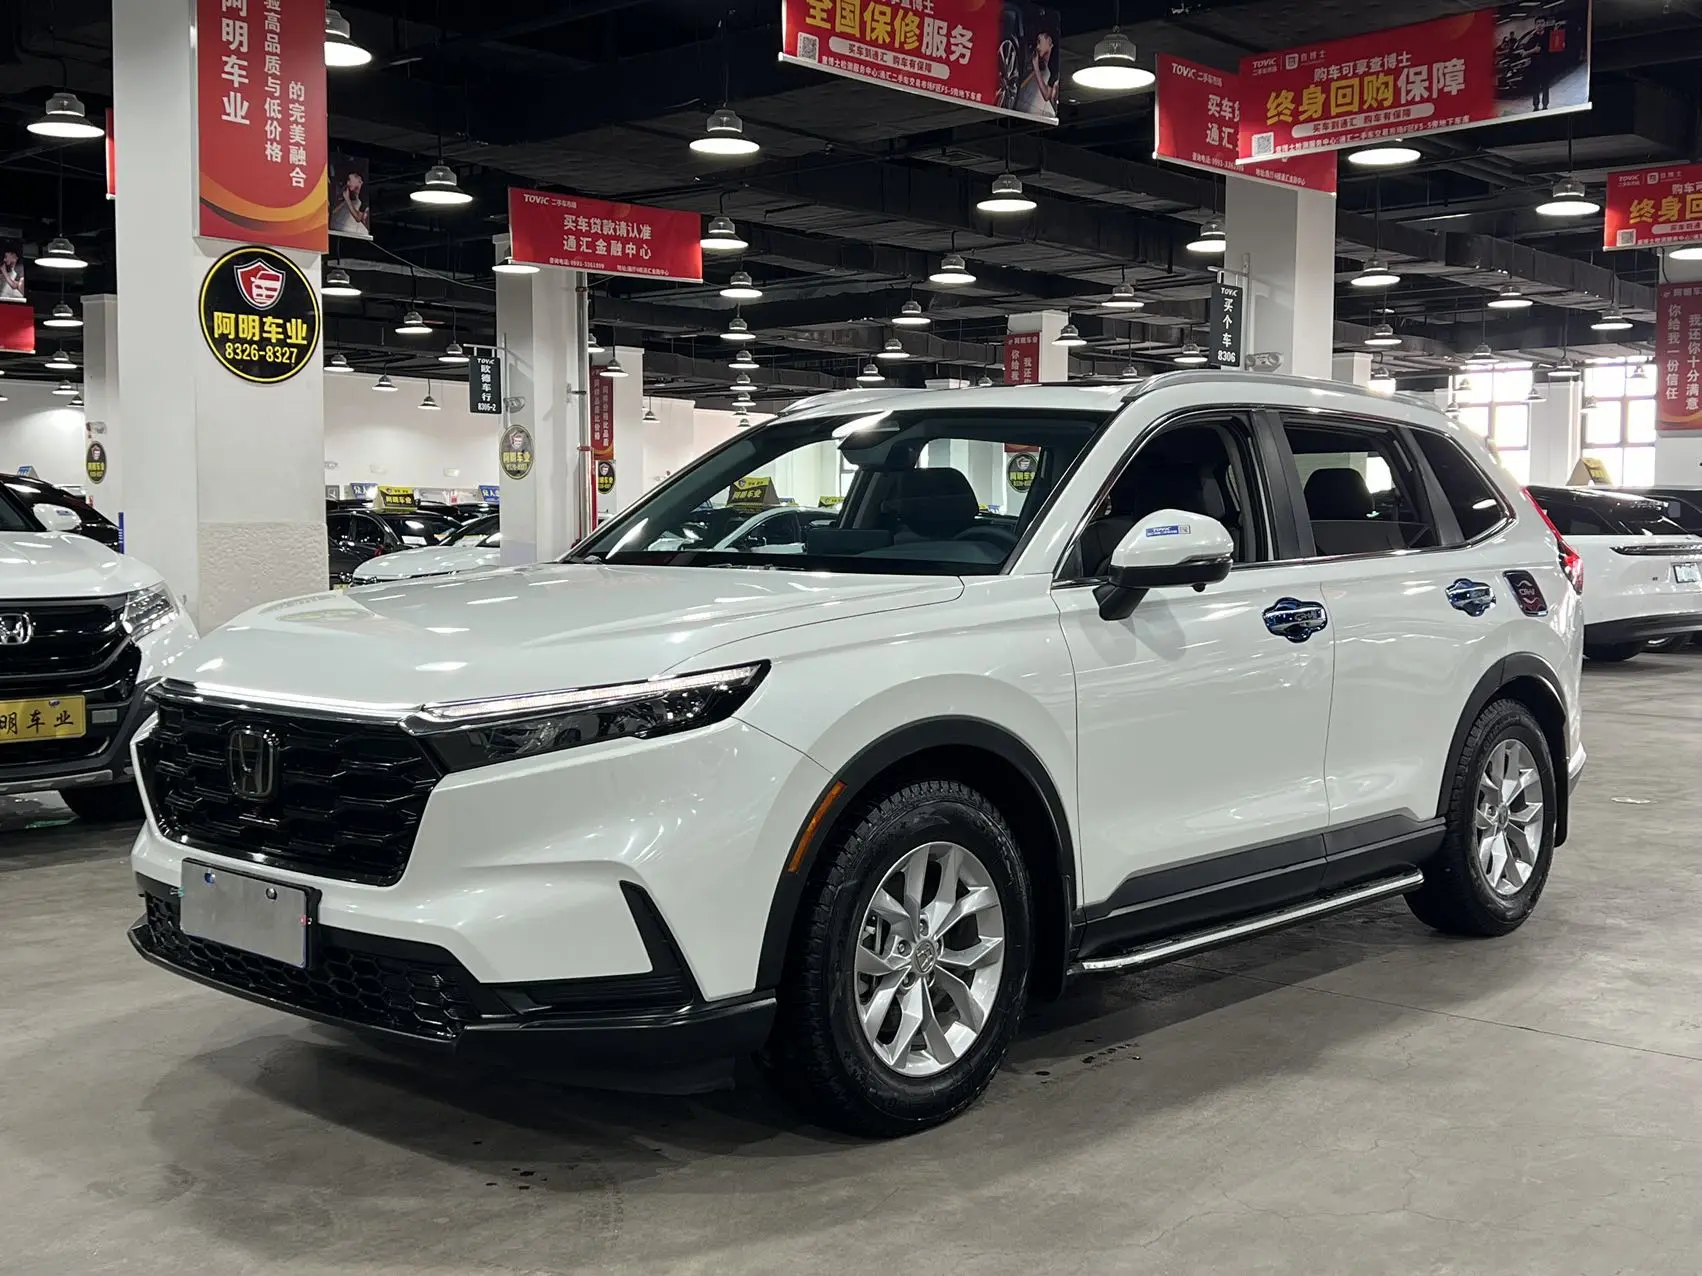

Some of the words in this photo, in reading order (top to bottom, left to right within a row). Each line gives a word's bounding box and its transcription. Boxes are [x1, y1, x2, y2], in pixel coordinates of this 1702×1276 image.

[805, 0, 974, 65] 全国保修服务
[848, 43, 888, 64] 买车到通汇
[1313, 51, 1413, 83] 购车可享查博士
[1266, 57, 1467, 126] 终身回购保障
[288, 81, 307, 188] 的完美融合
[1312, 118, 1358, 134] 买车到通汇
[1363, 107, 1412, 125] 购车有保障
[1206, 122, 1241, 151] 通汇
[1629, 194, 1702, 225] 终身回
[563, 213, 652, 241] 买车贷款请认准
[563, 234, 652, 261] 通汇金融中心
[213, 311, 308, 345] 阿明车业
[1221, 297, 1234, 348] 买个车
[225, 342, 299, 364] 8326-8327
[1217, 350, 1237, 363] 8306
[1666, 303, 1681, 401] 你给我一份信任
[1686, 313, 1702, 411] 我还你十分满意
[0, 709, 74, 735] 明车业
